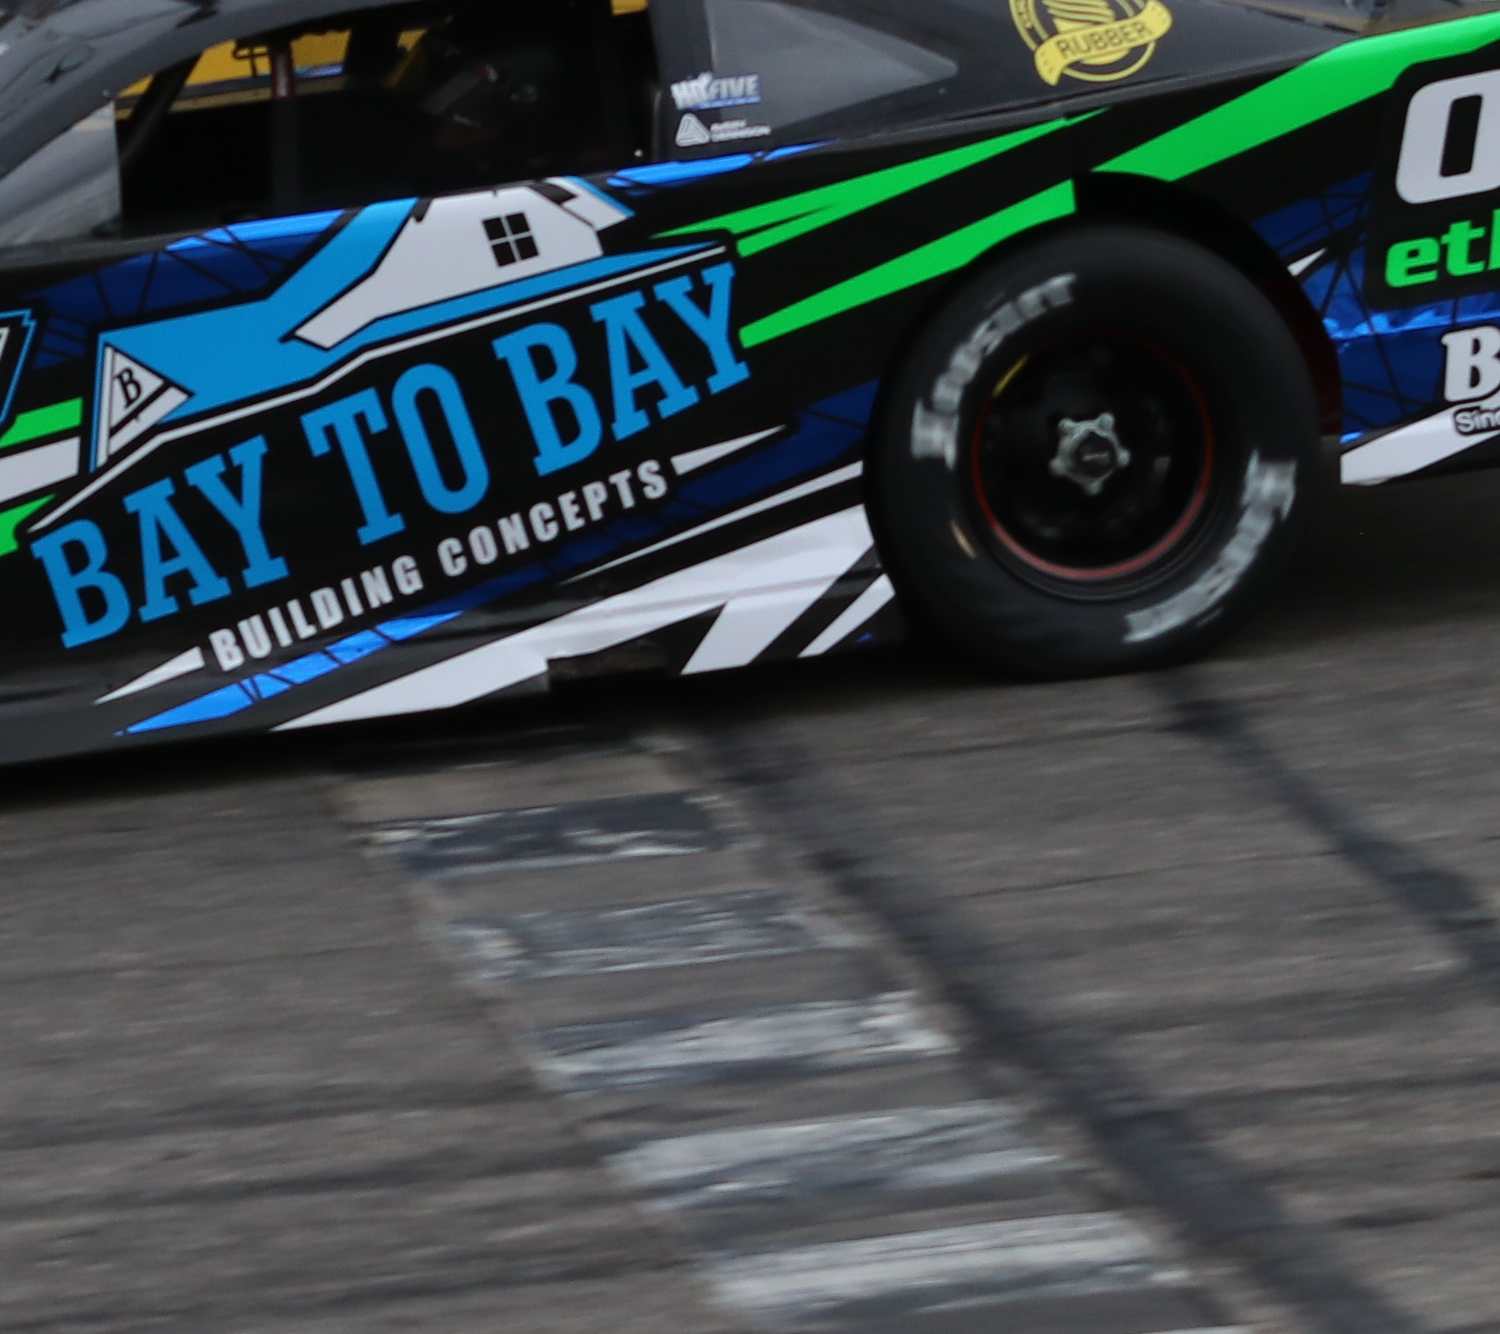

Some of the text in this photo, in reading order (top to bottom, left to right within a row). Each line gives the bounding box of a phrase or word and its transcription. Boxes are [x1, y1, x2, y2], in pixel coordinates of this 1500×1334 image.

[1056, 21, 1152, 59] RUBBER
[113, 367, 142, 409] B
[30, 263, 750, 649] BAY TO BAY
[208, 458, 670, 671] BUILDING CONCEPTS
